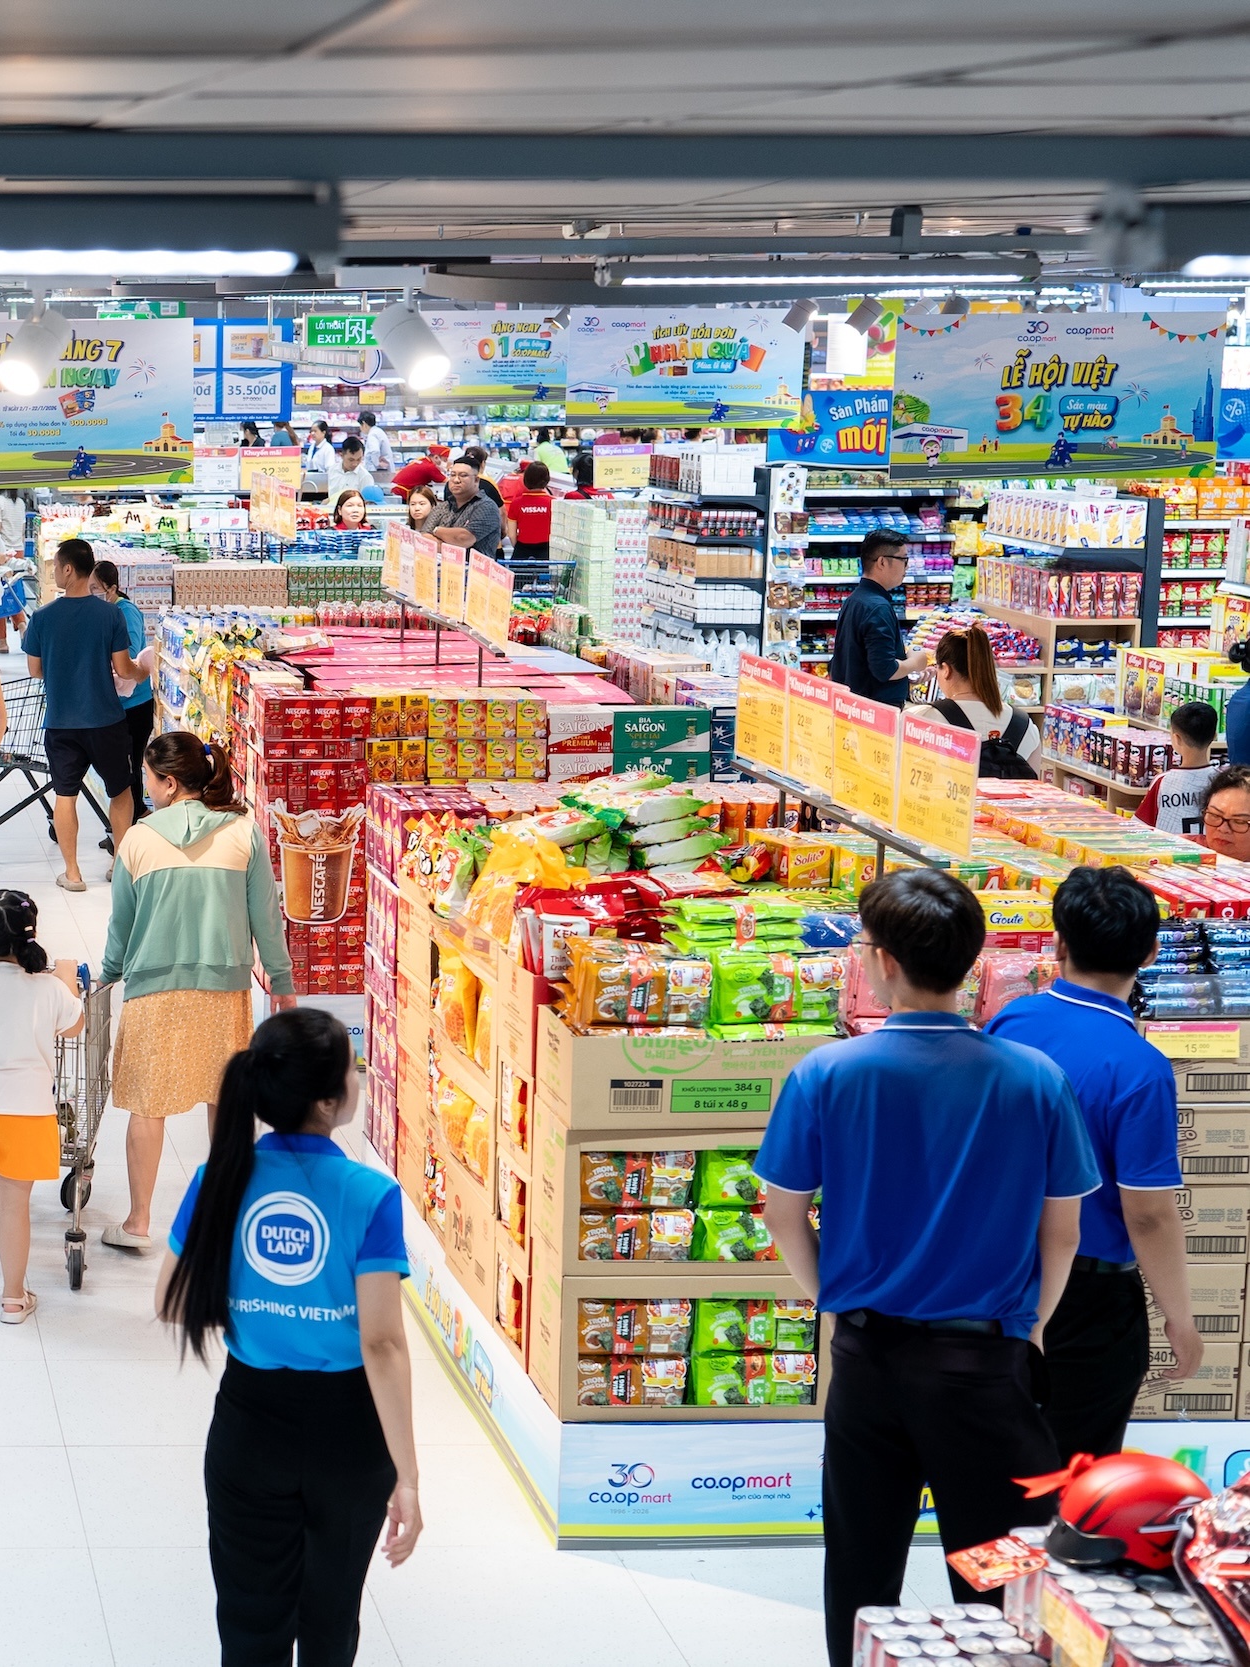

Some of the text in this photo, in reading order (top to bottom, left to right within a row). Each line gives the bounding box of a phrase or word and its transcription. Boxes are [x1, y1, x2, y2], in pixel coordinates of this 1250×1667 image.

[315, 320, 345, 331] LỐI THOÁT
[491, 320, 541, 336] TẶNG NGAY
[652, 325, 671, 341] TÍCH
[690, 324, 712, 339] HÓA
[713, 325, 737, 340] ĐƠN
[1027, 320, 1049, 335] 30
[1065, 325, 1114, 337] co.opmart
[59, 329, 123, 362] ÁNG 7
[317, 334, 343, 344] EXIT
[1017, 334, 1057, 344] co.opmart
[477, 336, 509, 361] 01
[651, 337, 702, 365] NHẬN
[60, 366, 121, 390] NGAY
[1001, 349, 1118, 391] LỄ HỘI VIỆT
[227, 385, 276, 396] 35.500đ
[829, 395, 889, 421] Sản Phẩm
[995, 393, 1051, 432] 34
[1066, 398, 1109, 411] Sắc màu
[1062, 411, 1113, 432] TỰ HÀO
[837, 416, 888, 453] mới
[244, 449, 283, 458] Khuyến mãi
[122, 509, 142, 524] An
[741, 659, 773, 680] Khuyến mãi
[789, 676, 828, 701] Khuyến mãi
[836, 697, 876, 724] Khuyến mãi
[557, 721, 607, 733] SAIGON
[624, 723, 666, 733] SAIGON
[905, 722, 952, 750] Khuyến mãi
[910, 768, 922, 787] 27
[946, 780, 958, 801] 30
[794, 850, 823, 866] Solite
[308, 853, 327, 920] NESCAFÉ
[990, 912, 1023, 925] Gouté
[1185, 1044, 1197, 1053] 15
[734, 1083, 762, 1094] 384 g
[694, 1100, 701, 1108] 8
[703, 1099, 716, 1108] túi
[726, 1100, 739, 1108] 48
[740, 1102, 748, 1110] g
[261, 1225, 310, 1243] DUTCH
[267, 1239, 306, 1256] LADY
[228, 1298, 356, 1322] URISHING VIETNAM
[607, 1462, 655, 1489] 30
[691, 1471, 792, 1492] co.opmart
[589, 1489, 672, 1507] co.opmart
[732, 1493, 746, 1501] bạn
[763, 1493, 776, 1501] mọi
